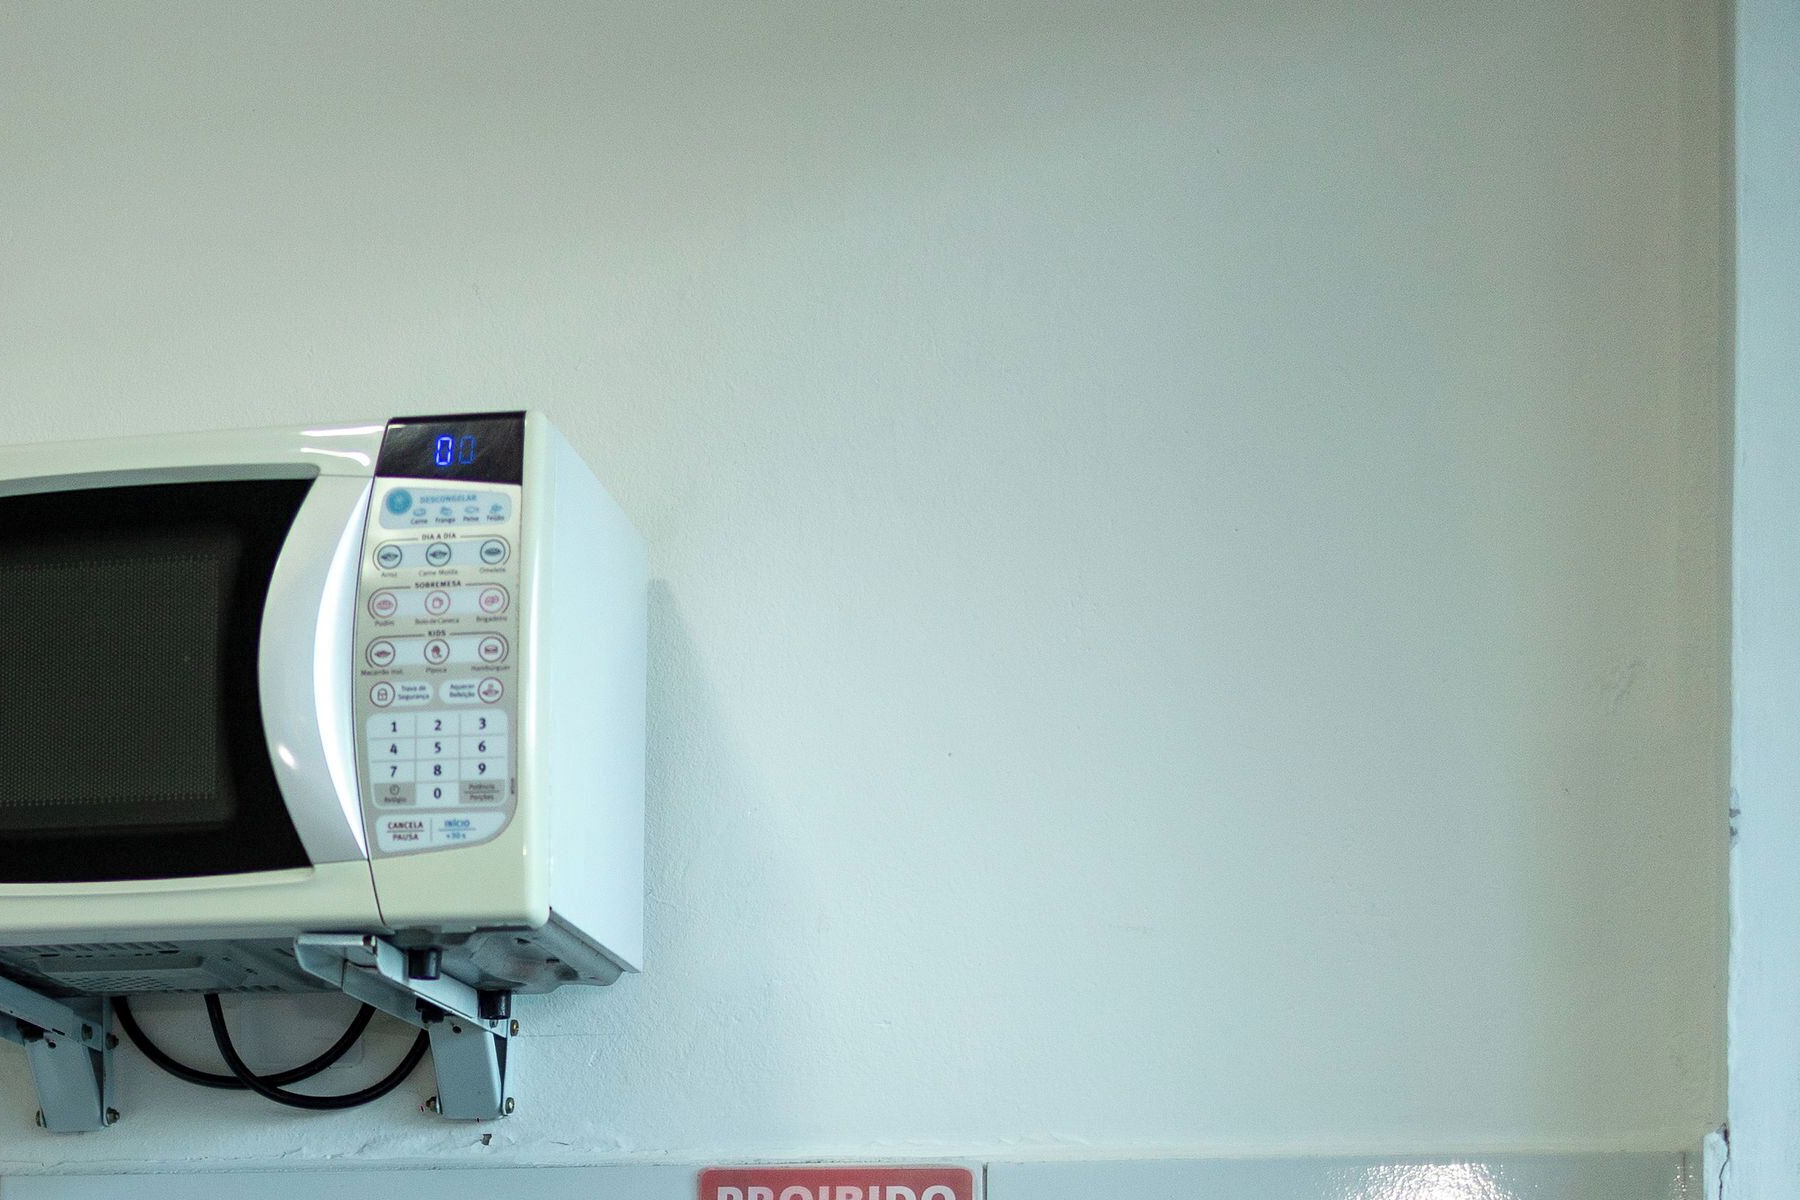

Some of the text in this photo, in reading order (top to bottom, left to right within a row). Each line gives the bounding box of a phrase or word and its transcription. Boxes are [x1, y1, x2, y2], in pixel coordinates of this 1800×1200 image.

[443, 532, 456, 540] DIA
[414, 580, 462, 589] SOBREMESA
[428, 629, 447, 637] KIDS
[391, 721, 397, 732] 1
[434, 719, 442, 731] 2
[479, 717, 486, 730] 3
[390, 743, 398, 755] 4
[434, 741, 442, 753] 5
[478, 740, 486, 752] 6
[390, 765, 398, 778] 7
[433, 764, 442, 776] 8
[478, 762, 486, 775] 9
[433, 787, 442, 799] 0
[387, 821, 424, 829] CANCELA
[444, 818, 470, 828] INÍCIO
[392, 833, 418, 841] PAUSA
